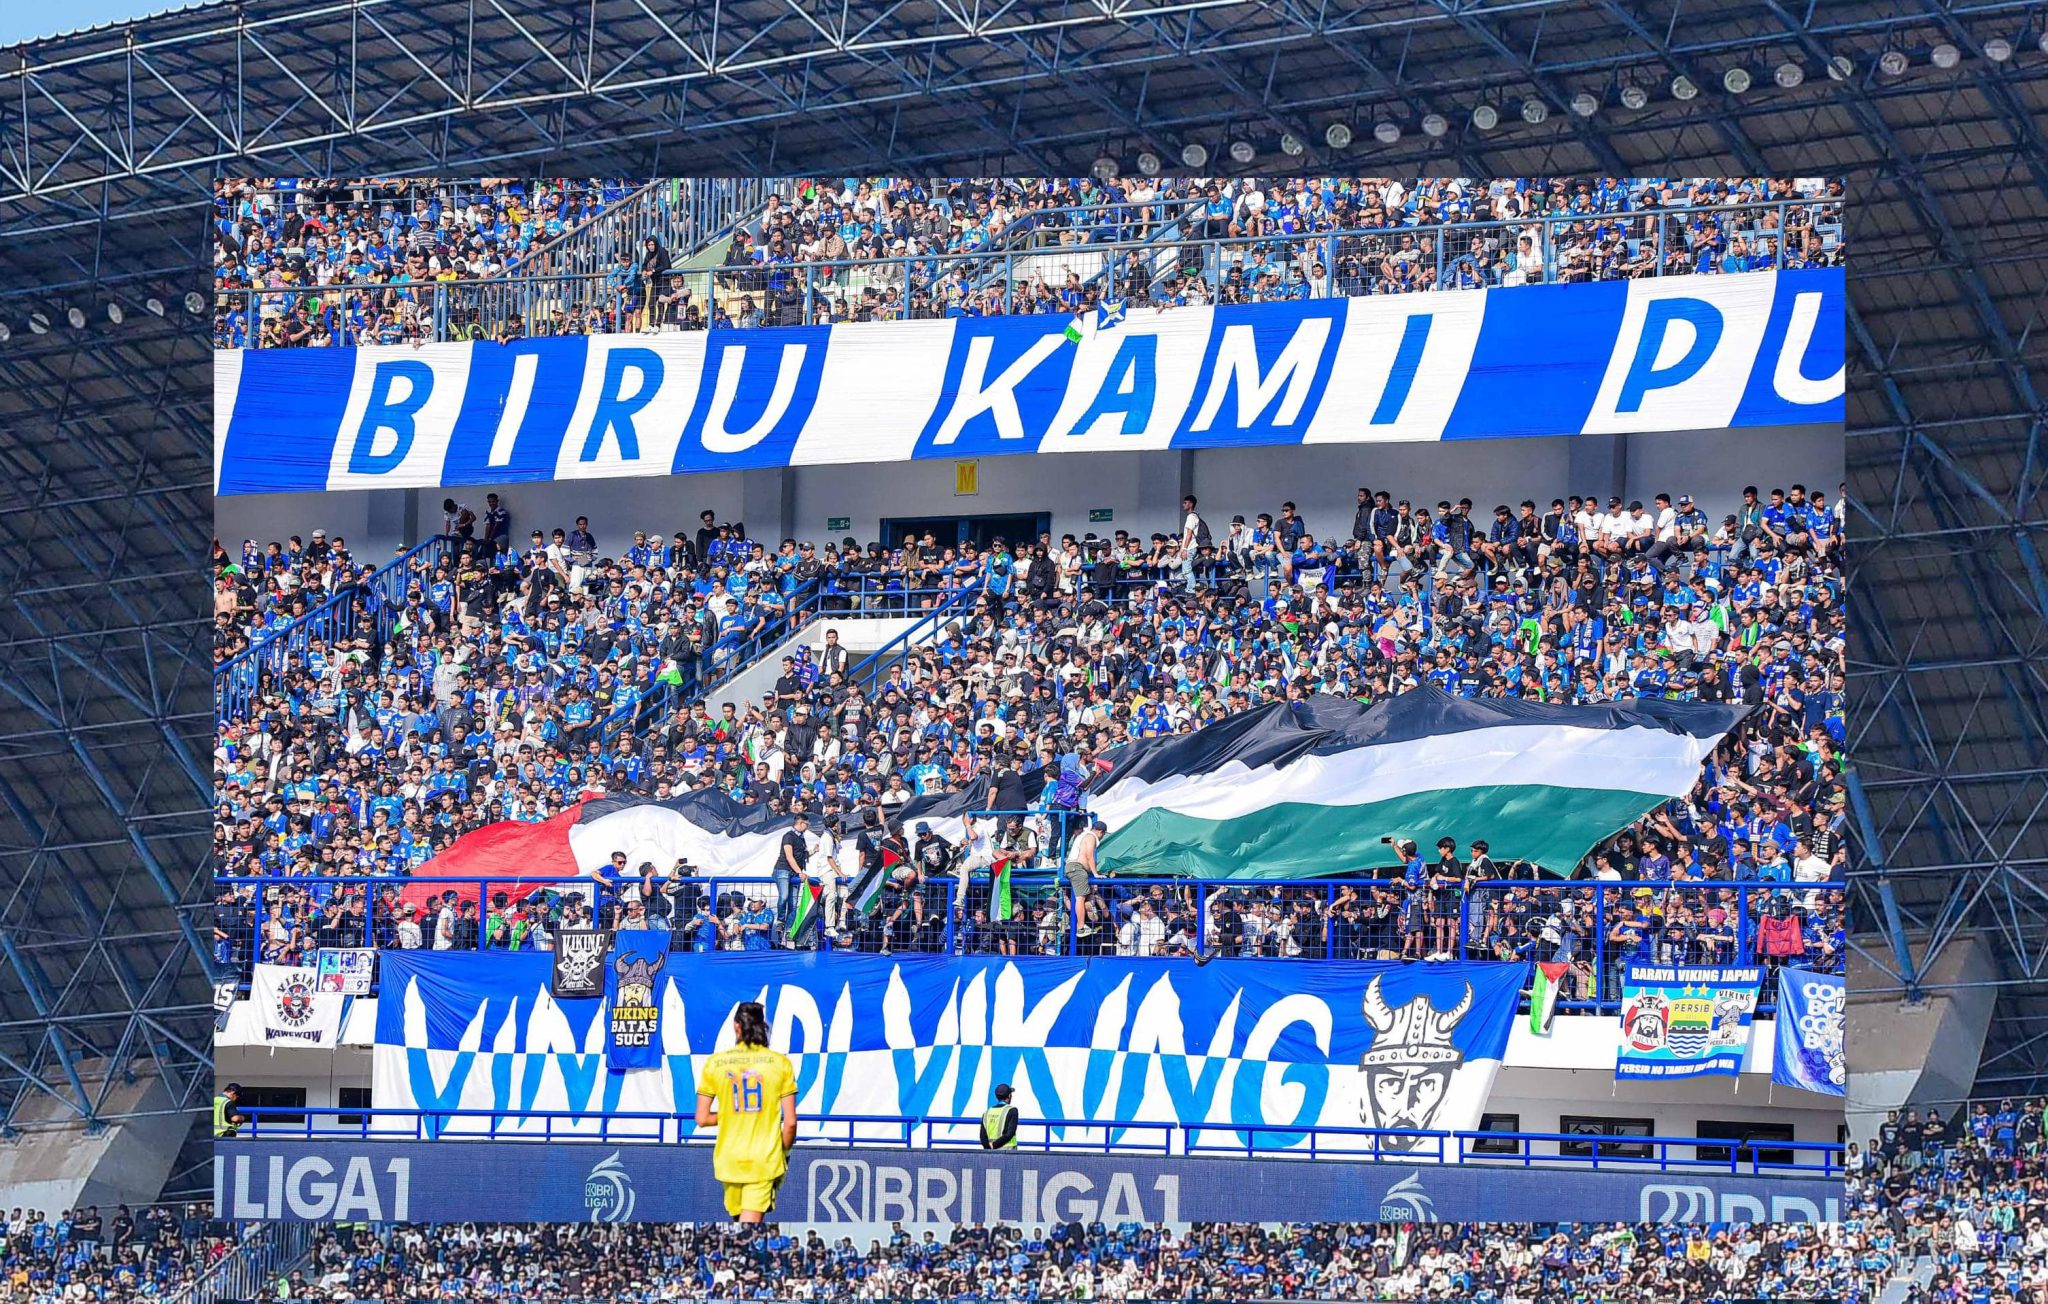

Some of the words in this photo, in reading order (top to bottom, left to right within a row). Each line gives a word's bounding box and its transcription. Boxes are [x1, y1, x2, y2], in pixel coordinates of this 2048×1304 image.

[347, 343, 808, 474] BIRU
[931, 313, 1435, 445] KAMI
[959, 465, 976, 492] M
[562, 934, 604, 957] VIKING
[1631, 968, 1675, 981] BARAYA
[1677, 968, 1719, 982] VIKING
[1720, 969, 1759, 982] JAPAN
[1719, 990, 1751, 1000] VIKING
[612, 1007, 658, 1020] VIKING
[1674, 1004, 1710, 1012] PERSIB
[611, 1020, 657, 1032] BATAS
[616, 1033, 650, 1045] SUCI
[882, 961, 1334, 1148] VIKING
[727, 1070, 763, 1112] 18
[597, 1184, 613, 1196] BRI
[585, 1198, 608, 1207] LIGA
[1393, 1207, 1412, 1220] BRI
